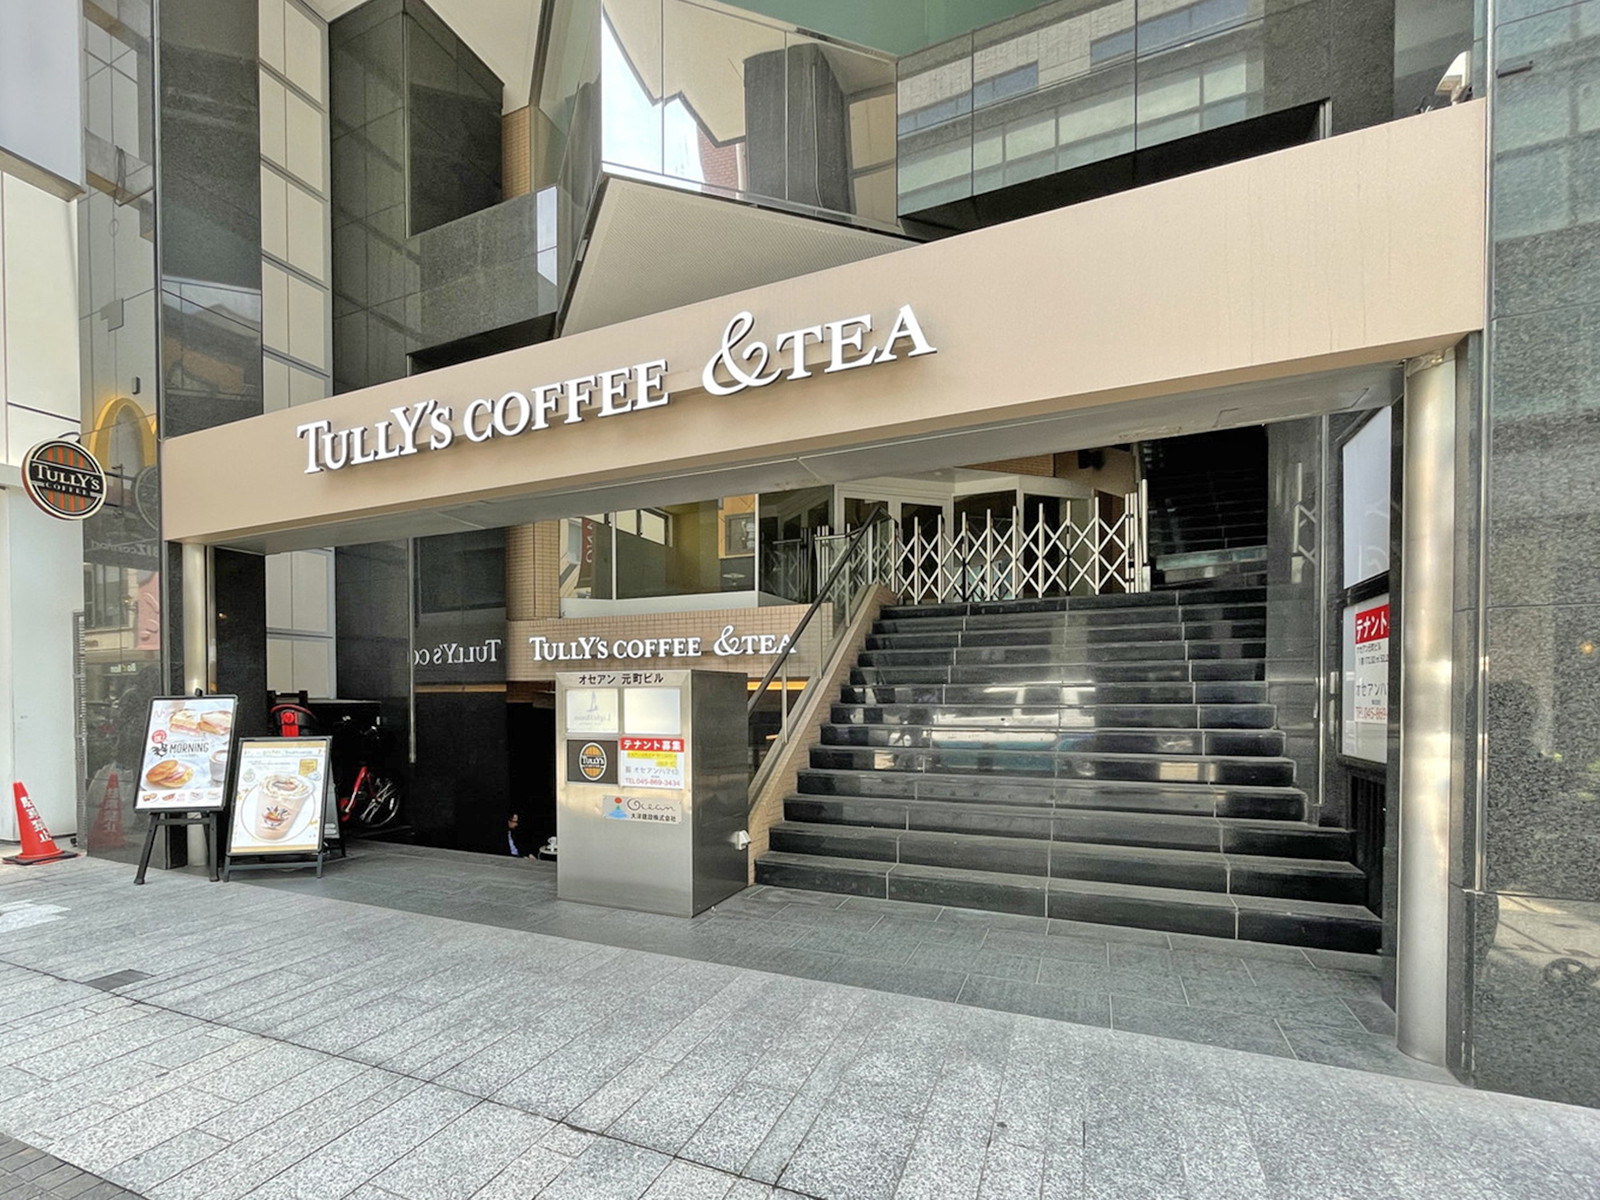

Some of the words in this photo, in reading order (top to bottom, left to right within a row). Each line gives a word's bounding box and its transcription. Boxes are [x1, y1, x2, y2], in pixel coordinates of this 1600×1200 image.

[463, 358, 670, 444] COFFEE
[45, 482, 91, 496] COFFEE
[1356, 611, 1389, 643] テナント
[613, 638, 702, 659] COFFEE
[579, 674, 616, 685] オセアン
[621, 673, 664, 685] 元町ビル
[1356, 683, 1388, 697] オセアンハ
[169, 742, 209, 754] MORNING
[624, 740, 681, 751] テナント募集
[626, 798, 676, 812] Ocean
